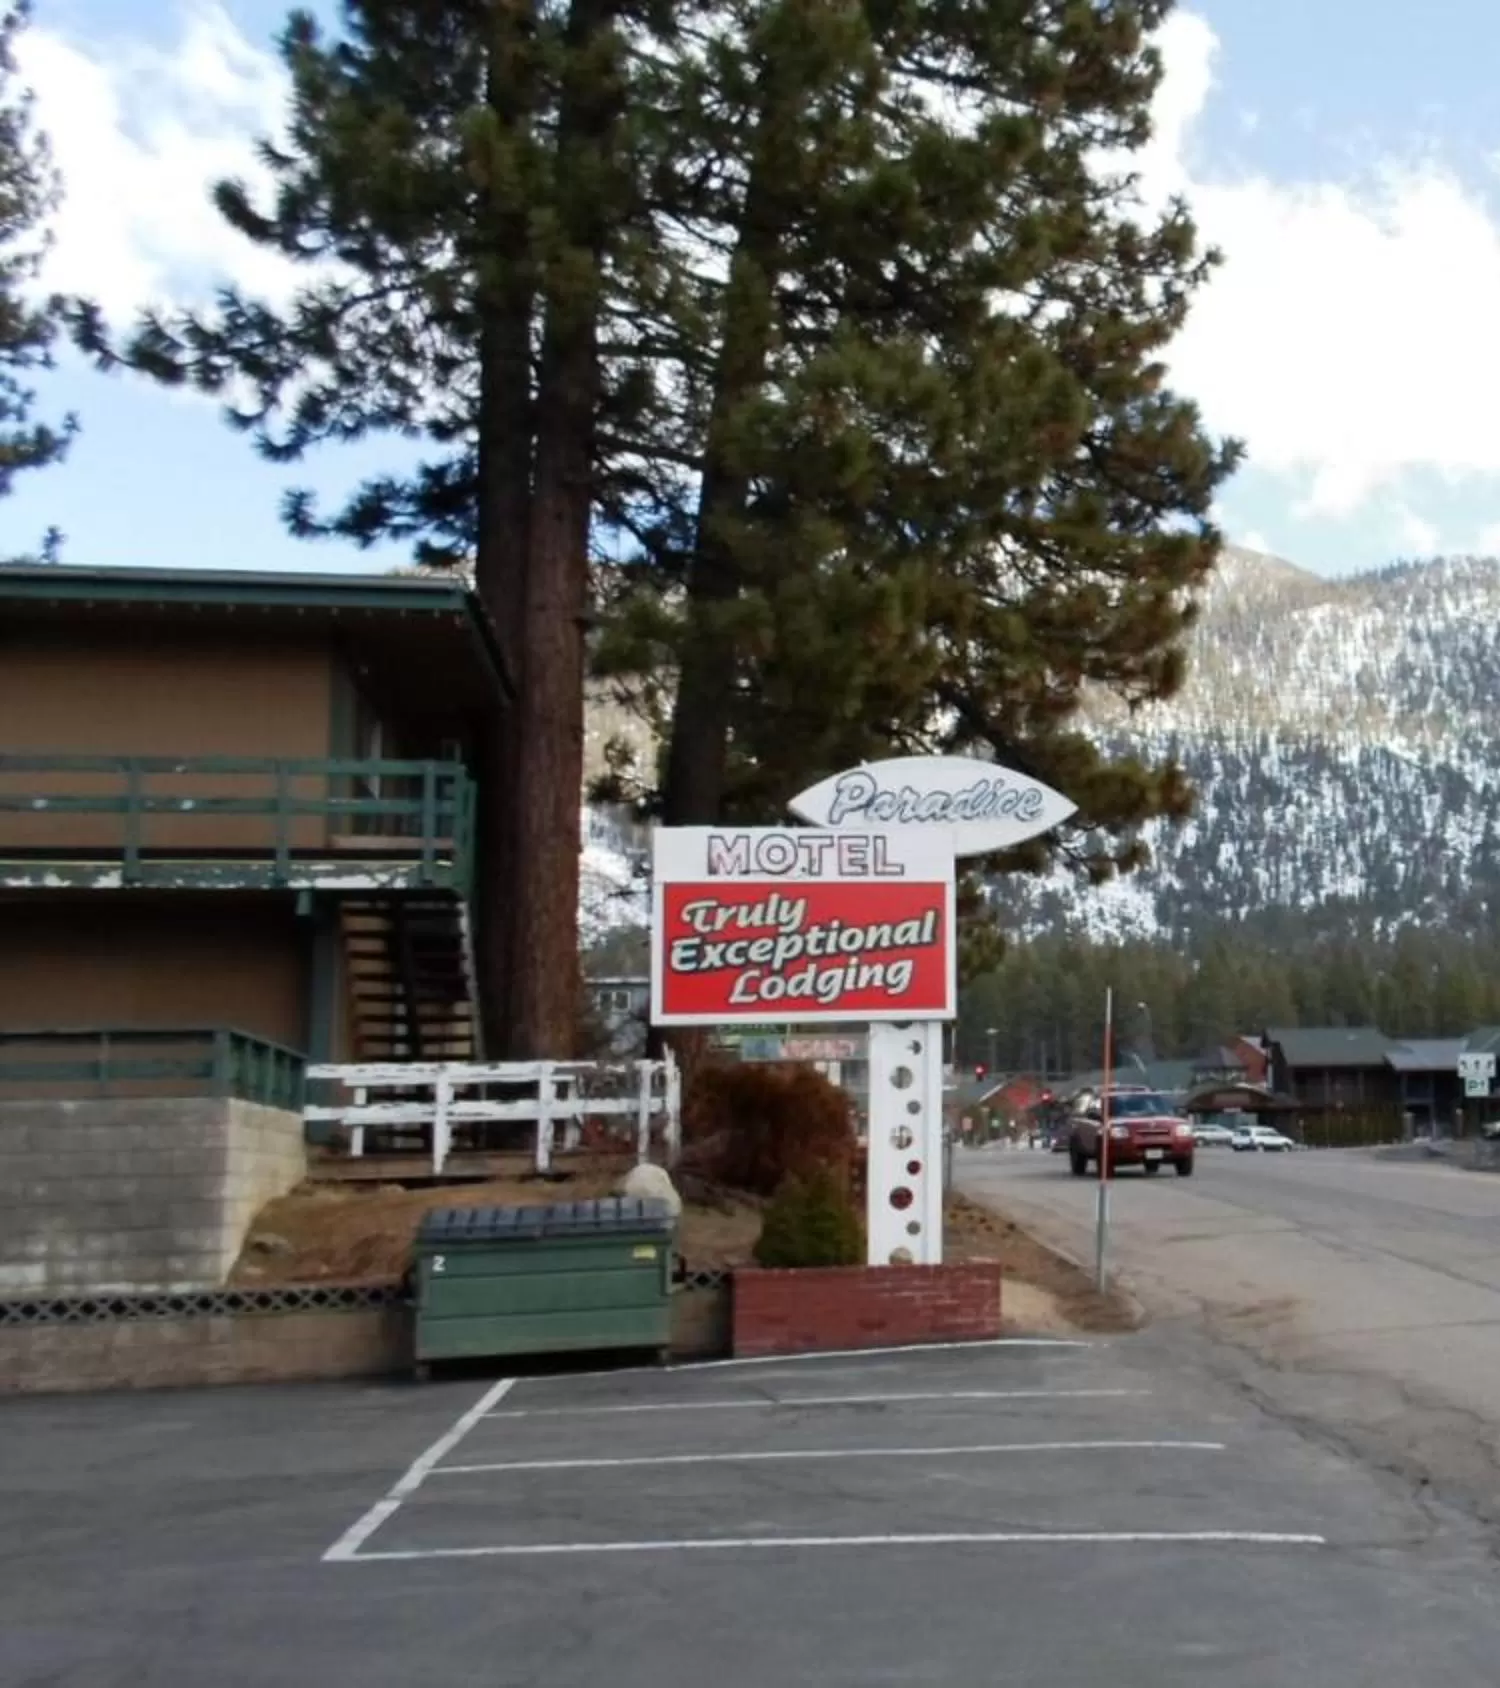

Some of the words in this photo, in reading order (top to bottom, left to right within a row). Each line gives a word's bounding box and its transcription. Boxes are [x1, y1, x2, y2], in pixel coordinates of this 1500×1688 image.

[828, 770, 1045, 825] Paradise
[707, 833, 905, 876] MOTEL
[681, 892, 806, 933] Truly
[670, 909, 936, 971] Exceptional
[728, 955, 913, 1004] Lodging
